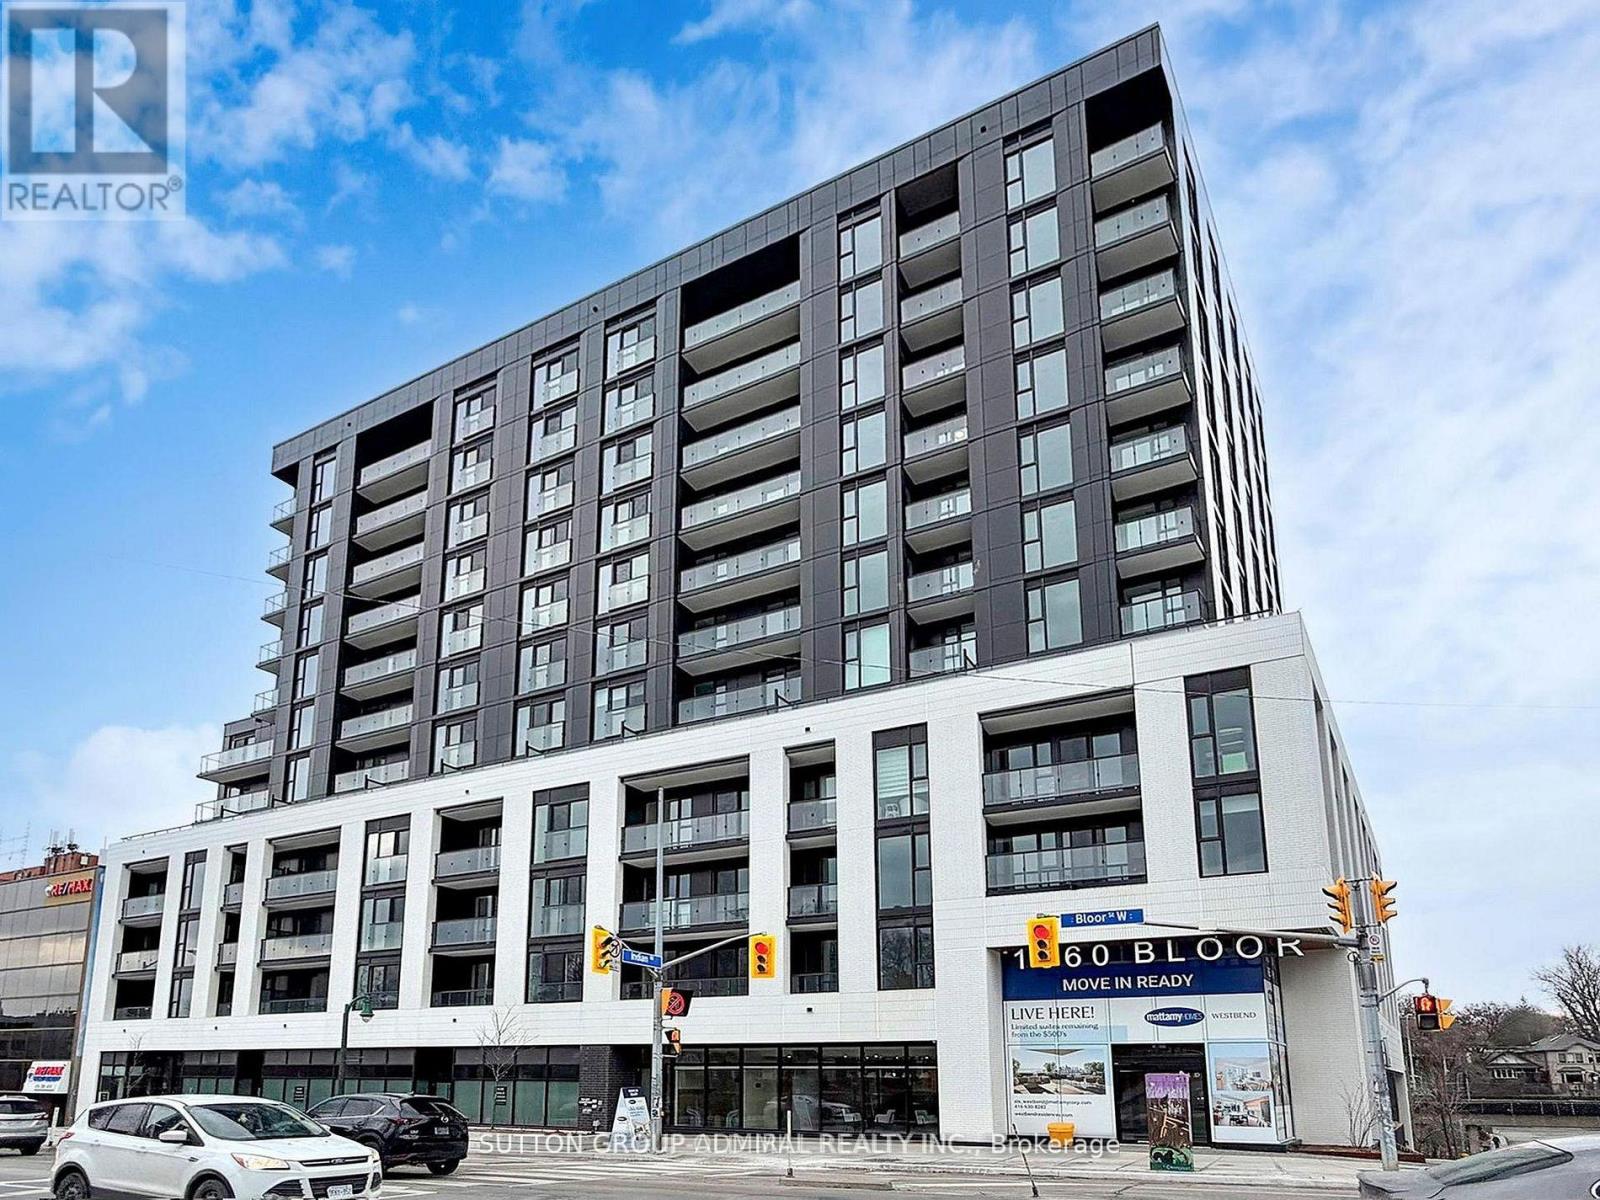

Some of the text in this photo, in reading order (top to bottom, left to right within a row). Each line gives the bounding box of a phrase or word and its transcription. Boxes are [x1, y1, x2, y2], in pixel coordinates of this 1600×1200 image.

[1075, 913, 1107, 924] Bloor
[1115, 911, 1127, 922] W
[1013, 935, 1305, 970] 160 BLOOR
[1062, 974, 1194, 992] MOVE IN READY
[1011, 1006, 1095, 1020] LIVE HERE!
[1211, 1011, 1257, 1020] WESTBEND
